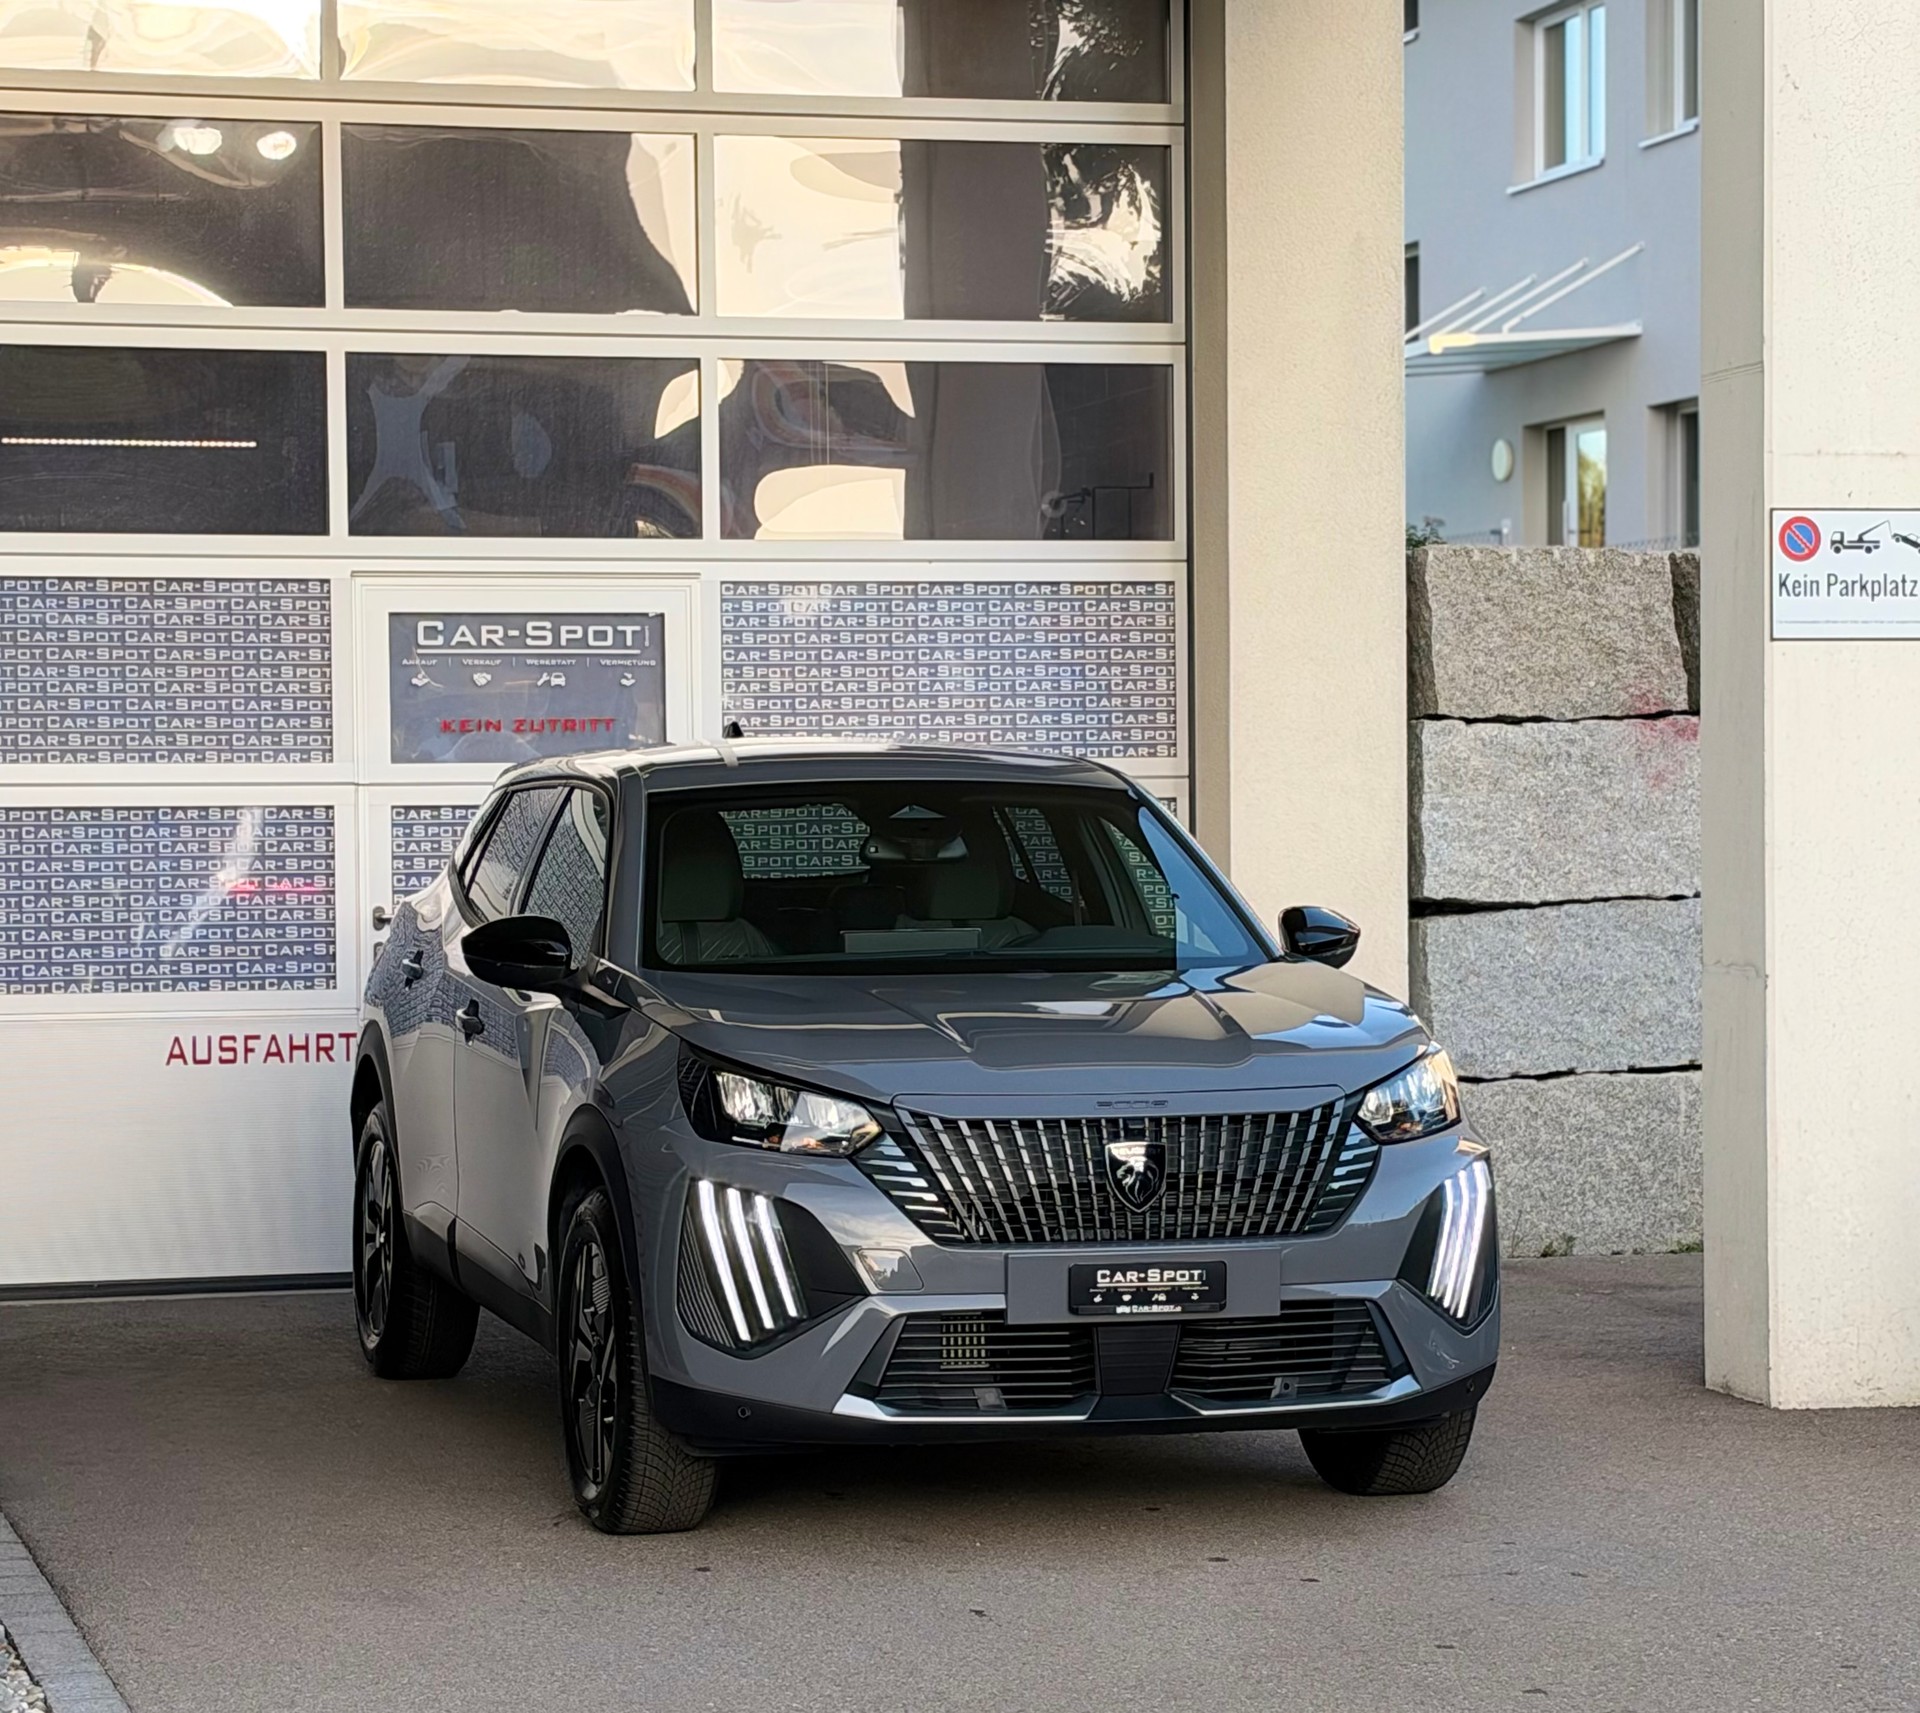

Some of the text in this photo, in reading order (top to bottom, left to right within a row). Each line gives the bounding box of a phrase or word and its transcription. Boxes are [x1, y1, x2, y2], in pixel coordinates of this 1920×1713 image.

[45, 579, 150, 592] CAR-SPOT
[153, 580, 256, 593] CAR-SPOT
[722, 583, 818, 595] CAR-SPOT
[918, 584, 1012, 595] CAR-SPOT
[1014, 584, 1108, 595] CAR-SPOT
[1778, 573, 1918, 602] Kein Parkplatz
[16, 596, 122, 609] CAR-SPOT
[125, 597, 229, 610] CAR-SPOT
[891, 600, 986, 612] CAR-SPOT
[988, 600, 1081, 612] CAR-SPOT
[46, 612, 151, 625] CAR-SPOT
[154, 613, 257, 626] CAR-SPOT
[722, 616, 818, 627] CAR-SPOT
[820, 616, 915, 627] CAR-SPOT
[918, 615, 1012, 627] CAR-SPOT
[1015, 615, 1108, 627] CAR-SPOT
[17, 630, 122, 642] CAR-SPOT
[125, 630, 229, 643] CAR-SPOT
[417, 621, 641, 646] CAR-SPOT
[793, 632, 889, 643] CAR-SPOT
[891, 632, 986, 643] CAR-SPOT
[46, 648, 151, 660] CAR-SPOT
[154, 648, 257, 661] CAR-SPOT
[722, 649, 819, 661] CAR-SPOT
[820, 649, 916, 661] CAR-SPOT
[918, 649, 1012, 661] CAR-SPOT
[1015, 648, 1109, 660] CAR-SPOT
[17, 665, 122, 678] CAR-SPOT
[125, 665, 229, 678] CAR-SPOT
[794, 666, 889, 678] CAR-SPOT
[892, 665, 986, 677] CAR-SPOT
[989, 665, 1082, 677] CAR-SPOT
[47, 681, 151, 693] CAR-SPOT
[155, 681, 258, 693] CAR-SPOT
[723, 681, 819, 693] CAR-SPOT
[821, 681, 916, 692] CAR-SPOT
[919, 680, 1013, 692] CAR-SPOT
[1016, 680, 1109, 691] CAR-SPOT
[17, 698, 122, 711] CAR-SPOT
[125, 698, 229, 711] CAR-SPOT
[795, 697, 890, 709] CAR-SPOT
[892, 697, 987, 709] CAR-SPOT
[990, 696, 1083, 708] CAR-SPOT
[47, 716, 152, 728] CAR-SPOT
[155, 716, 258, 728] CAR-SPOT
[440, 717, 616, 733] KEIN ZUTRITT
[821, 714, 917, 726] CAR-SPOT
[919, 713, 1013, 726] CAR-SPOT
[1016, 713, 1109, 725] CAR-SPOT
[17, 734, 122, 746] CAR-SPOT
[126, 734, 229, 746] CAR-SPOT
[990, 730, 1084, 741] CAR-SPOT
[48, 751, 152, 763] CAR-SPOT
[156, 751, 258, 763] CAR-SPOT
[51, 809, 155, 822] CAR-SPOT
[158, 808, 261, 821] CAR-SPOT
[21, 826, 126, 839] CAR-SPOT
[130, 825, 233, 838] CAR-SPOT
[51, 842, 155, 855] CAR-SPOT
[21, 860, 126, 872] CAR-SPOT
[51, 877, 155, 890] CAR-SPOT
[21, 895, 126, 908] CAR-SPOT
[130, 894, 233, 907] CAR-SPOT
[51, 910, 155, 923] CAR-SPOT
[22, 928, 127, 941] CAR-SPOT
[130, 927, 233, 940] CAR-SPOT
[51, 945, 156, 959] CAR-SPOT
[158, 944, 262, 958] CAR-SPOT
[22, 963, 127, 977] CAR-SPOT
[130, 961, 233, 976] CAR-SPOT
[51, 980, 156, 994] CAR-SPOT
[158, 979, 262, 992] CAR-SPOT
[165, 1032, 358, 1066] AUSFAHRT
[1096, 1269, 1202, 1283] CAR-SPOT
